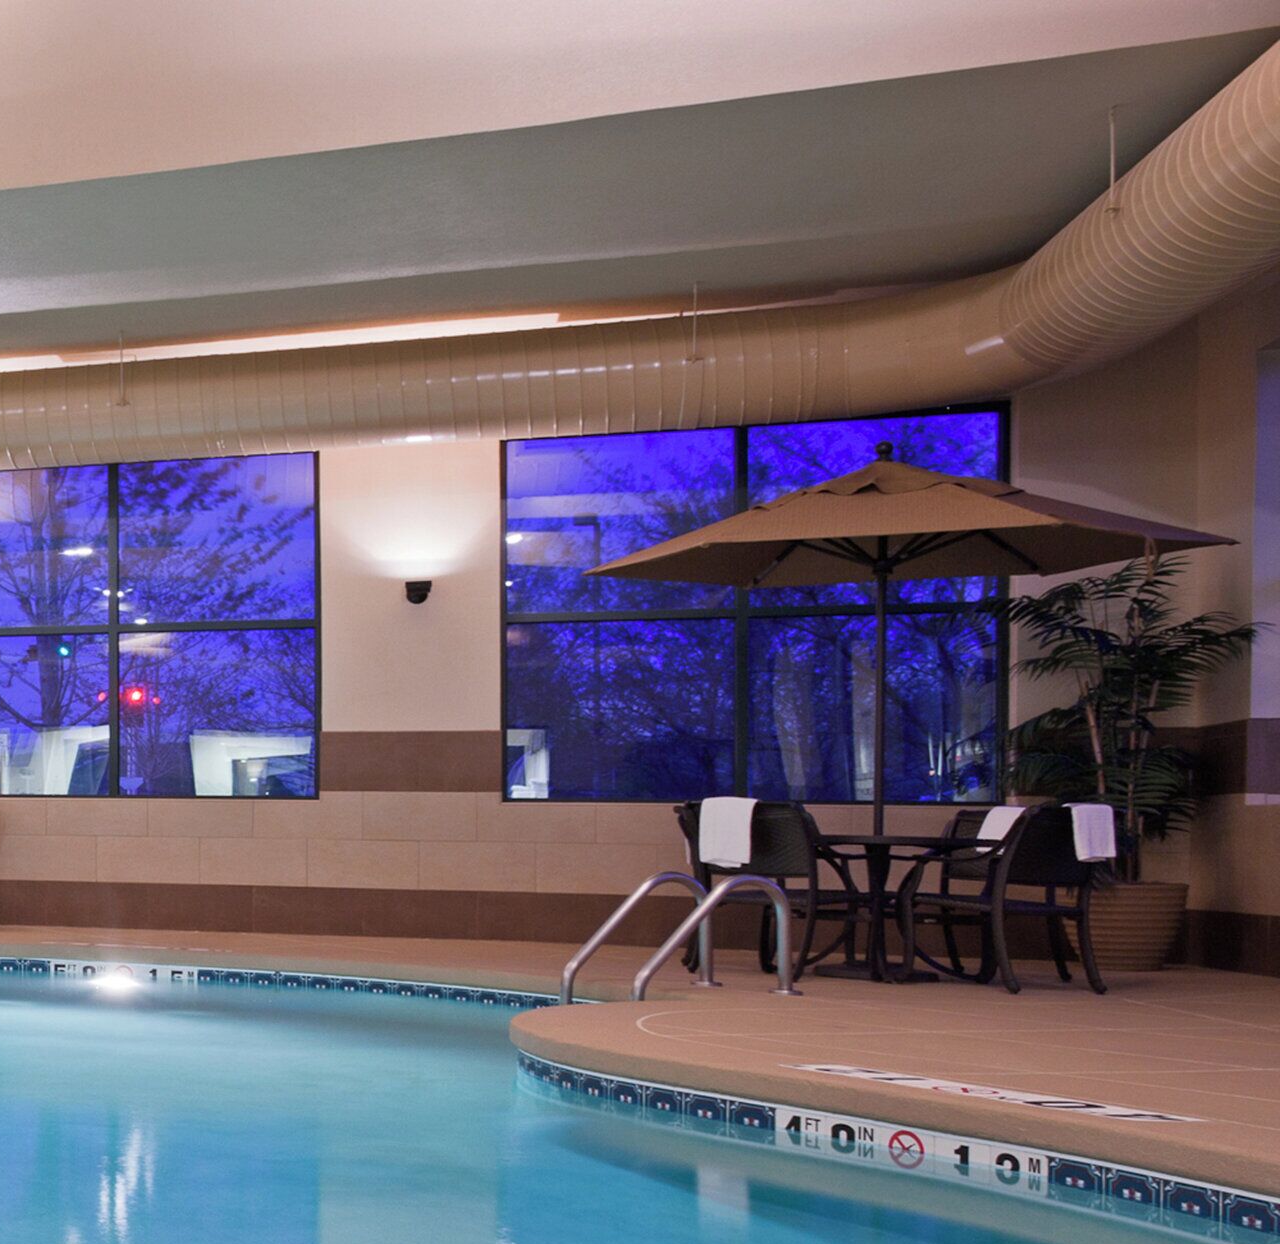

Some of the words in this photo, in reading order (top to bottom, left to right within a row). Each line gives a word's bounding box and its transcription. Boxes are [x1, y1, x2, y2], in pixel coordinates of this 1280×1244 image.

[805, 1117, 821, 1132] FT
[858, 1126, 875, 1142] IN
[1028, 1157, 1041, 1174] M
